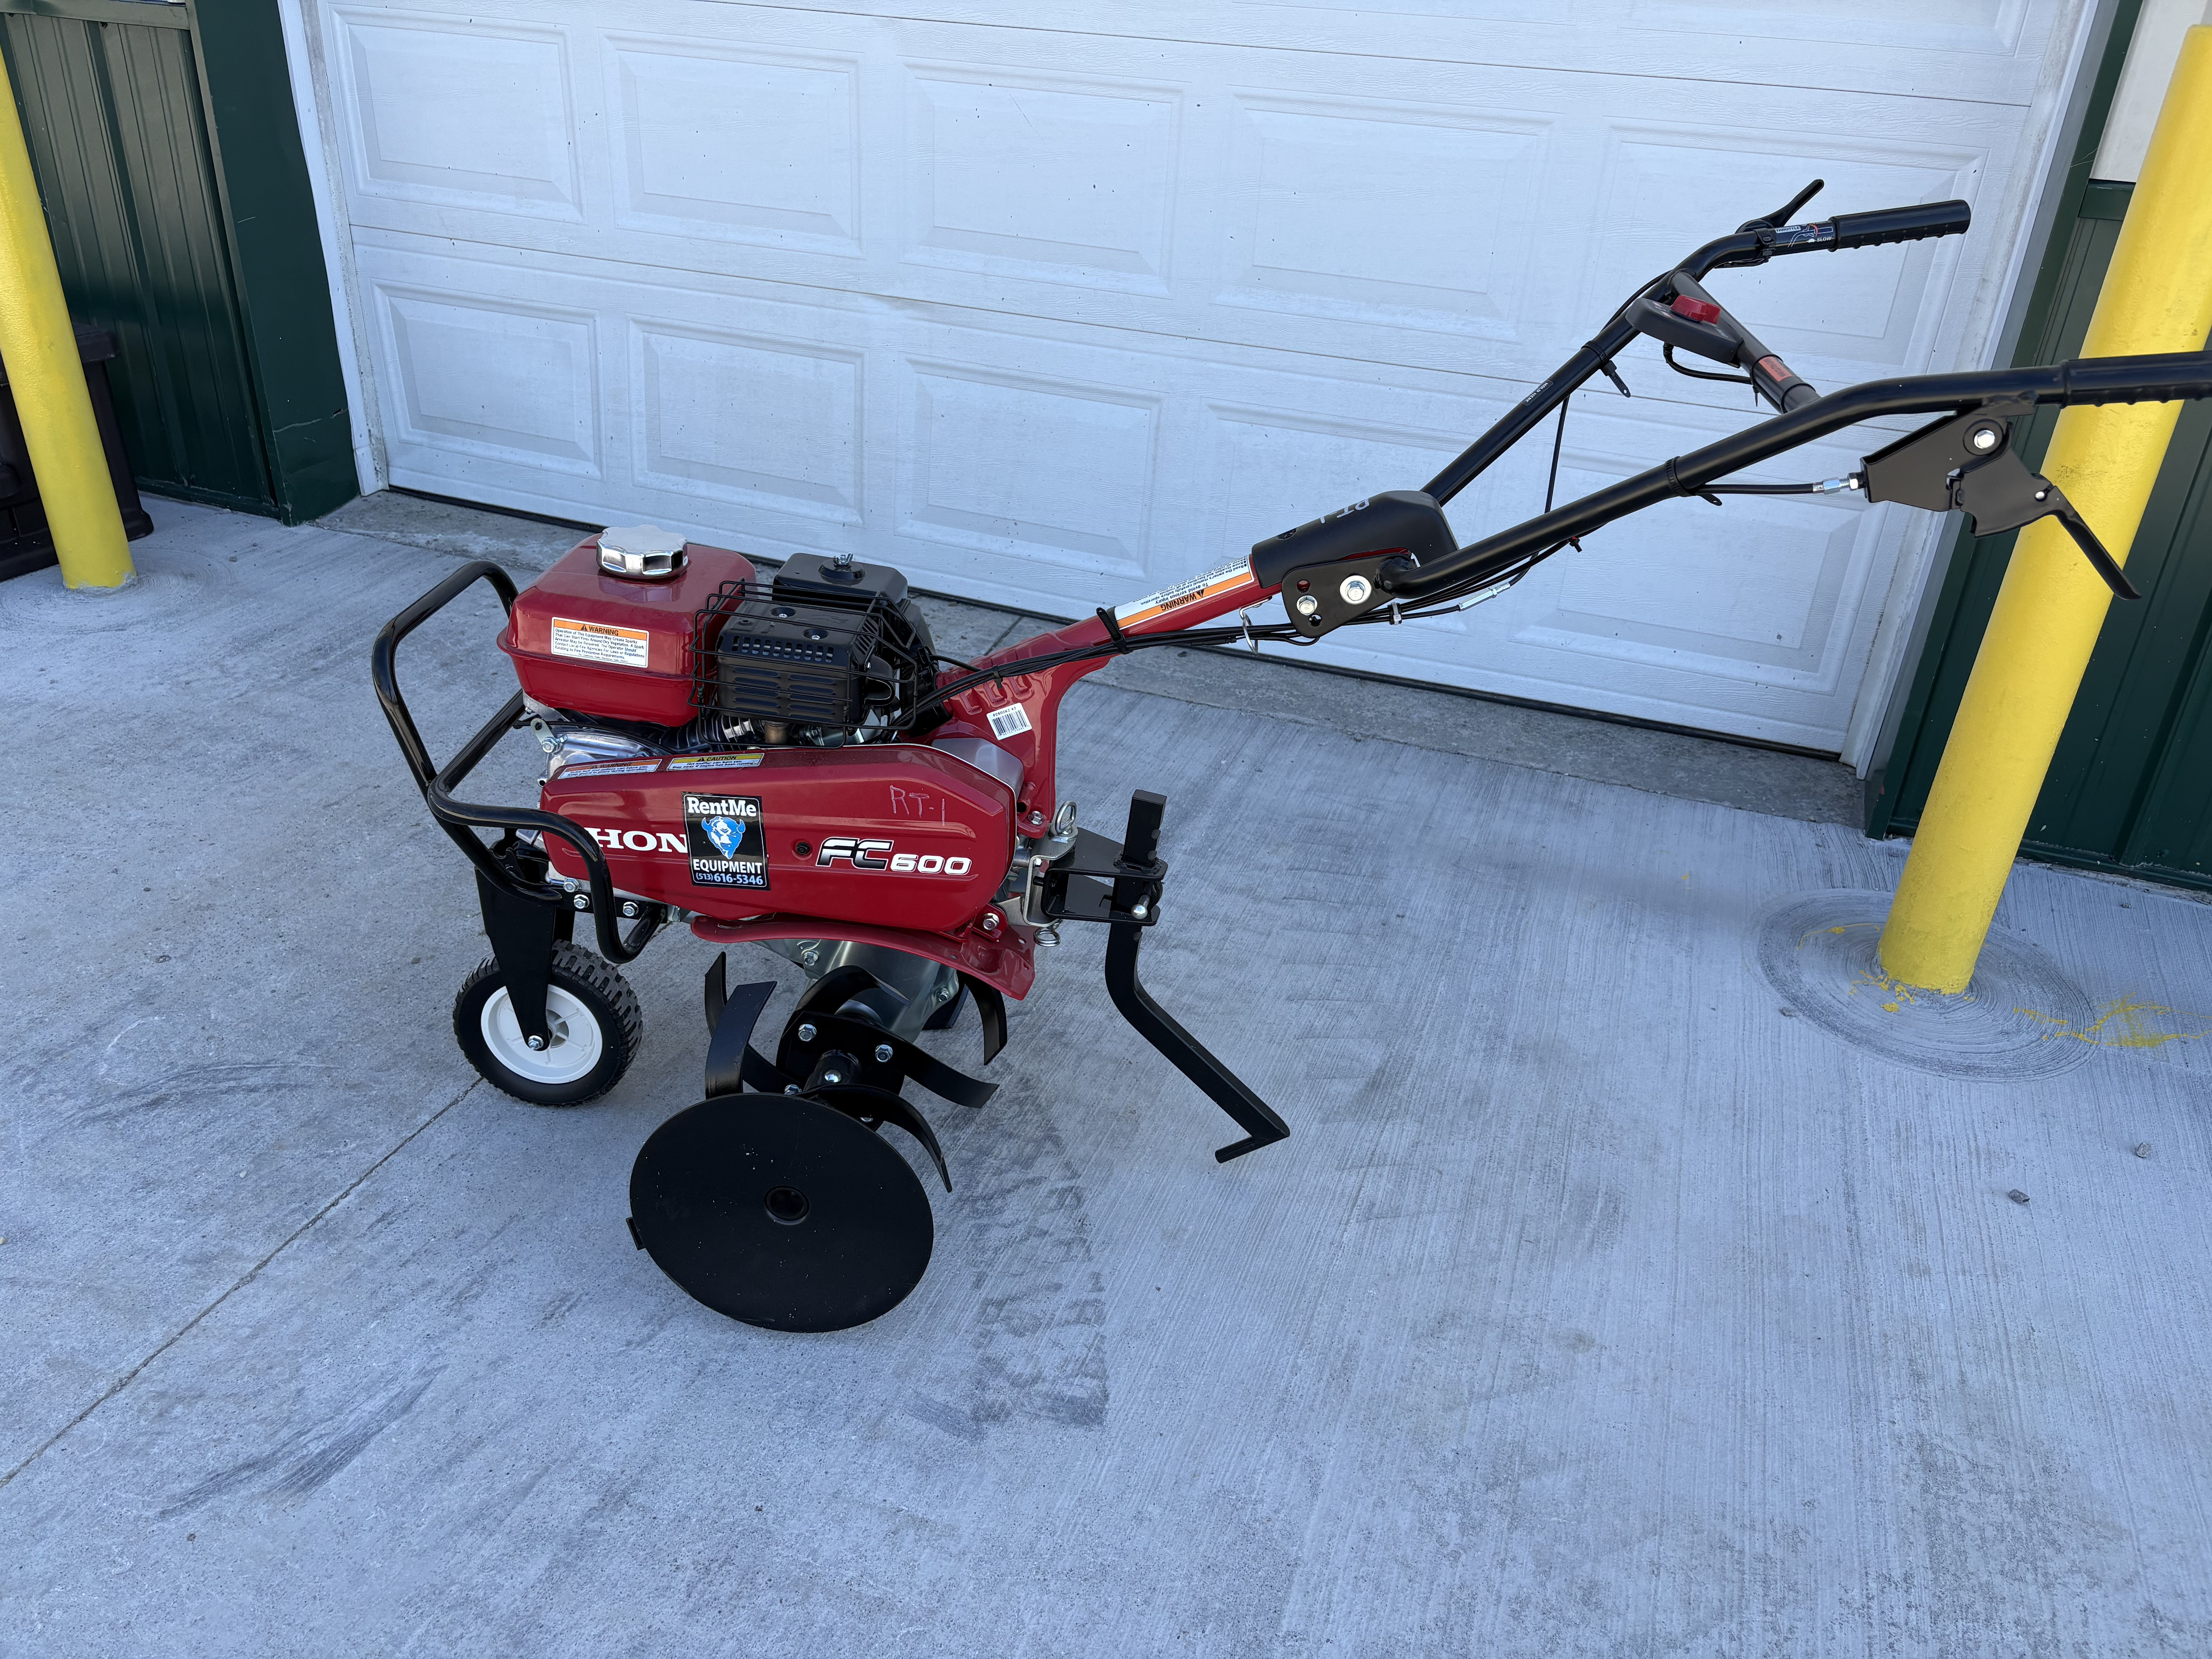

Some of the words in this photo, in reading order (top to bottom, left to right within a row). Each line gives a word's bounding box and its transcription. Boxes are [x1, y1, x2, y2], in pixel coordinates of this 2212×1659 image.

[1170, 590, 1187, 599] serious
[1188, 584, 1200, 593] avoid
[1160, 593, 1197, 611] WARNING
[589, 626, 618, 636] WARNING
[687, 797, 756, 817] RentMe
[890, 785, 945, 826] RT-1
[584, 827, 688, 853] HON
[693, 859, 762, 874] EQUIPMENT
